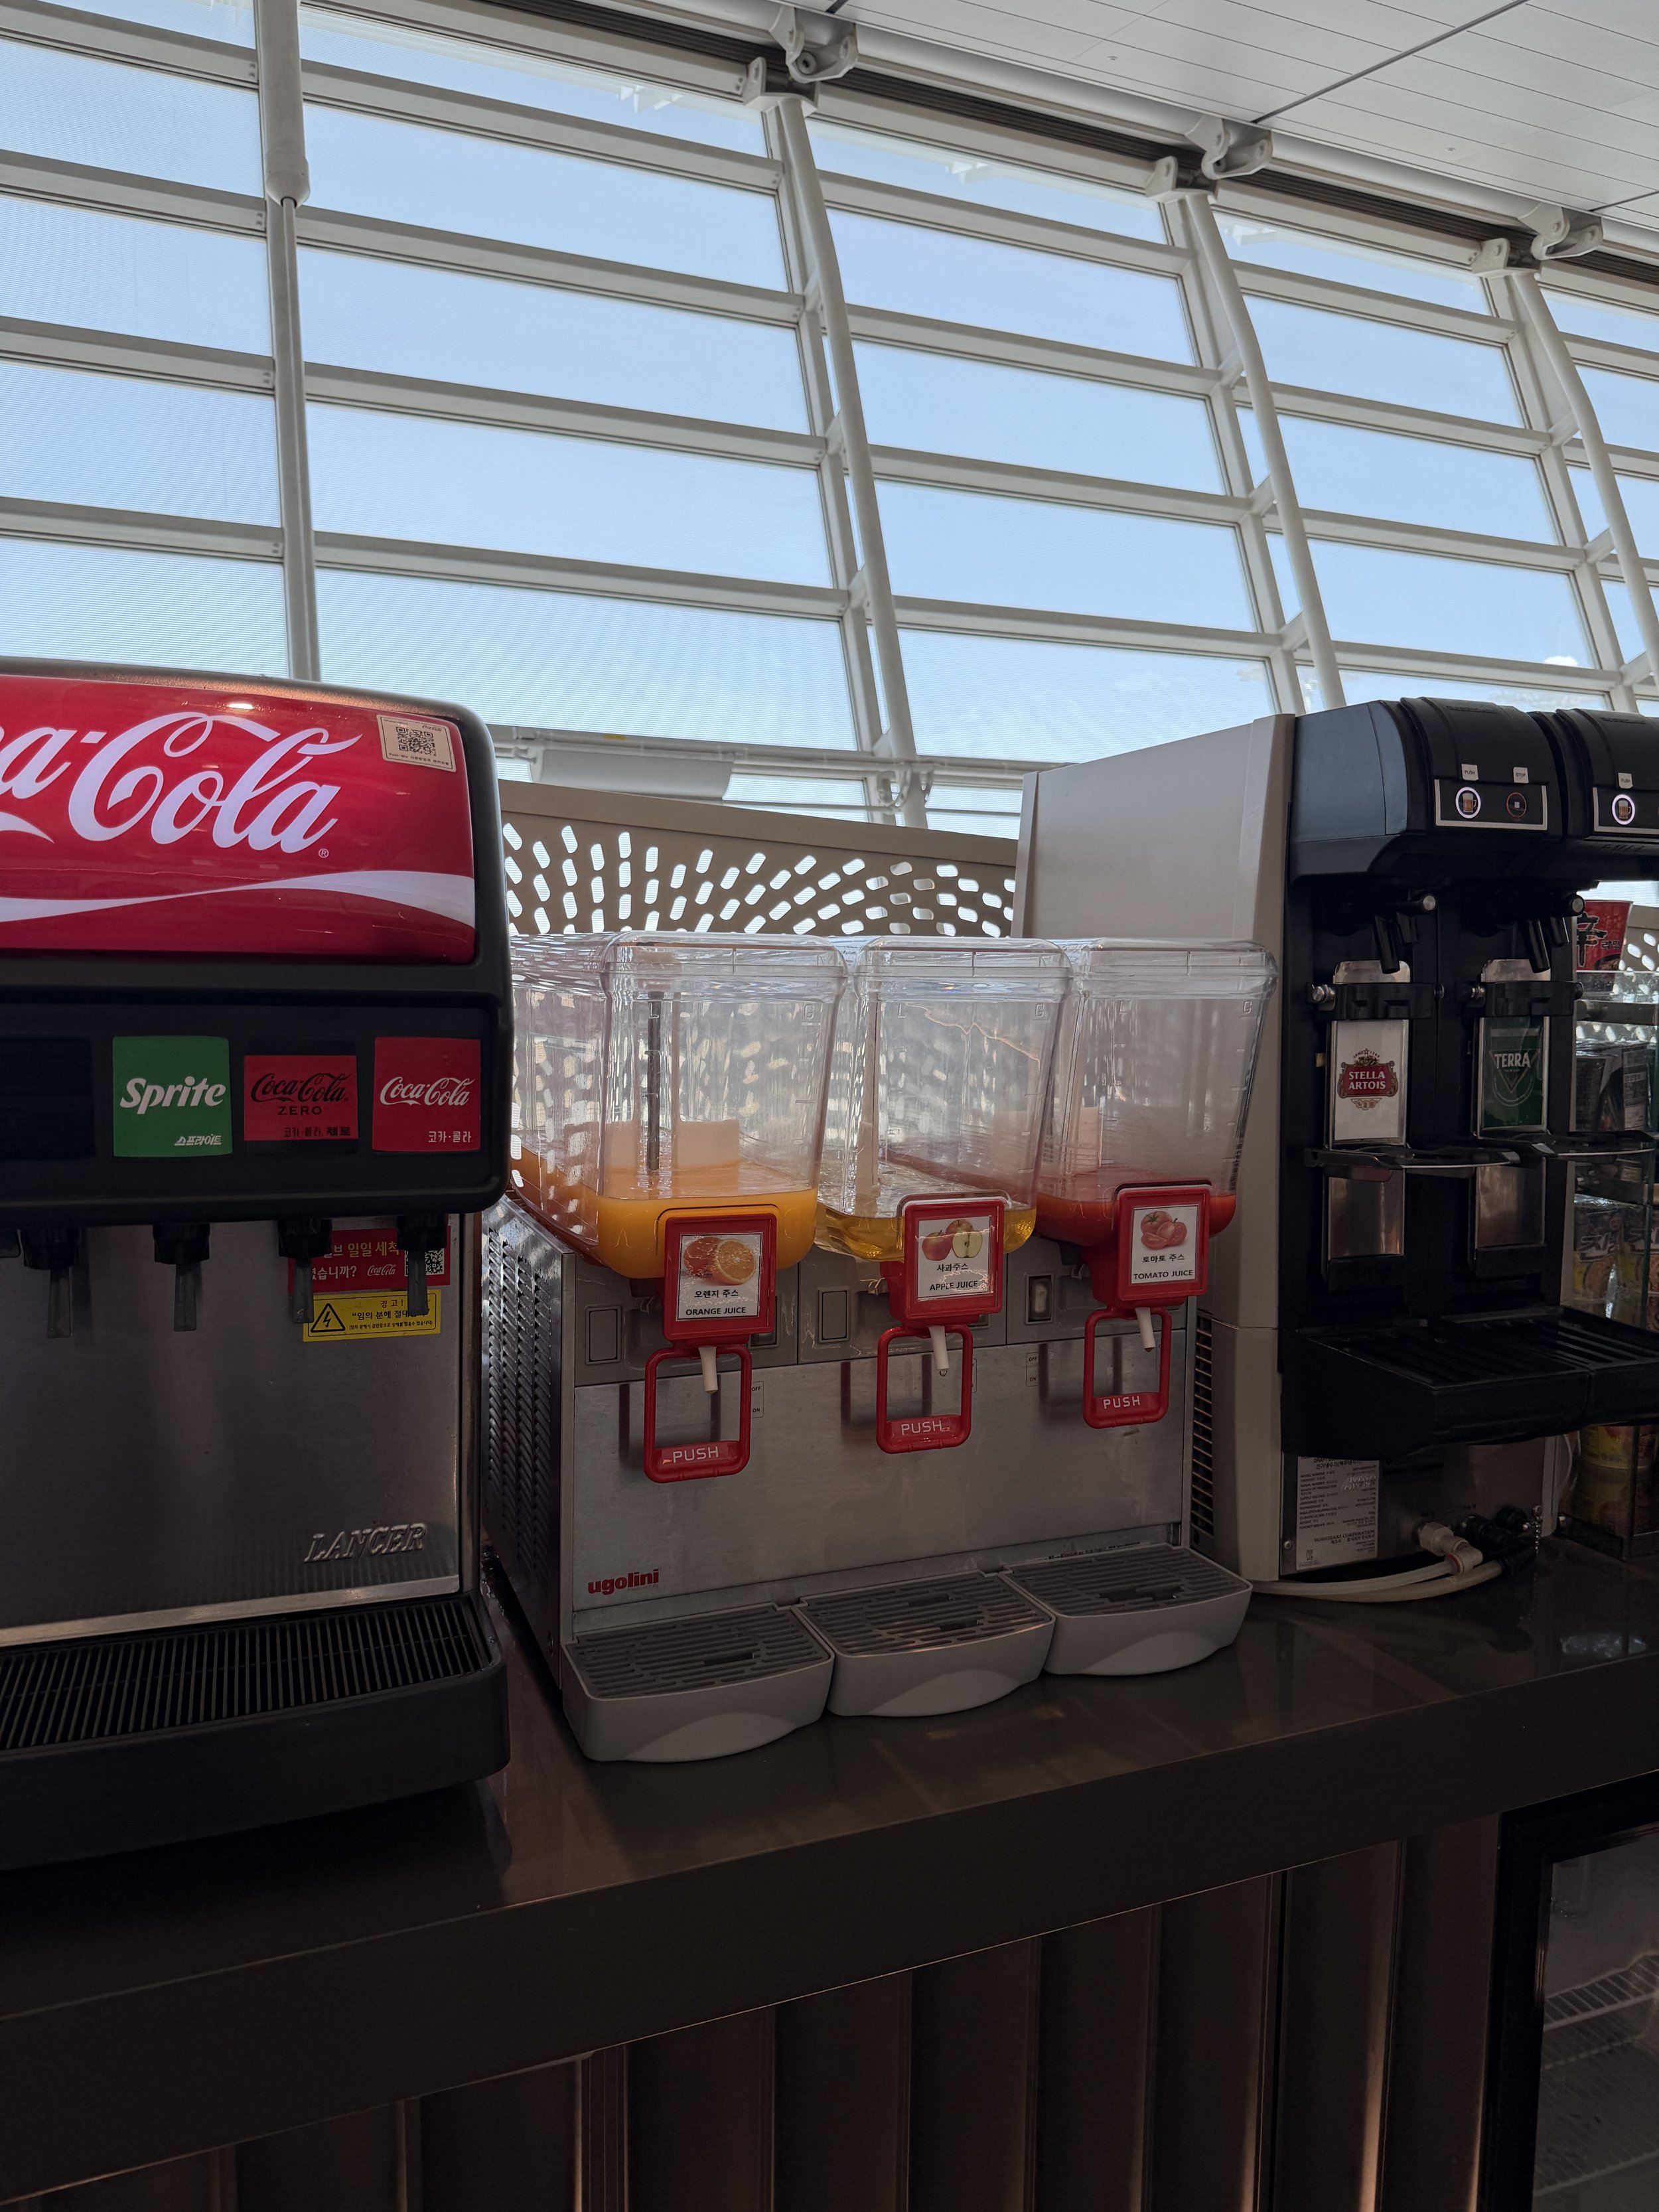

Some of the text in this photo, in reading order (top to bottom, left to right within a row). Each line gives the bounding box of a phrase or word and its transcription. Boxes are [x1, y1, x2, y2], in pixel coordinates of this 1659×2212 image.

[1494, 1053, 1531, 1069] TERRA
[1348, 1070, 1385, 1080] STELLA
[251, 1072, 352, 1103] Coca-Cola
[380, 1076, 476, 1106] Coca-Cola
[1348, 1081, 1386, 1090] ARTOIS
[119, 1076, 226, 1115] Sprite
[277, 1106, 323, 1116] ZERO
[326, 1126, 352, 1137] 제로
[174, 1134, 222, 1146] 스프라이트
[348, 1242, 372, 1258] 일일
[376, 1240, 399, 1256] 세척
[367, 1264, 397, 1276] Coca-Cola
[937, 1263, 968, 1272] 사과주스
[930, 1280, 978, 1291] APPLE JUICE
[1103, 1396, 1141, 1410] PUSH
[901, 1420, 942, 1436] PUSH
[673, 1446, 719, 1463] PUSH
[304, 1522, 428, 1563] LANCER
[588, 1569, 659, 1595] ugolini
